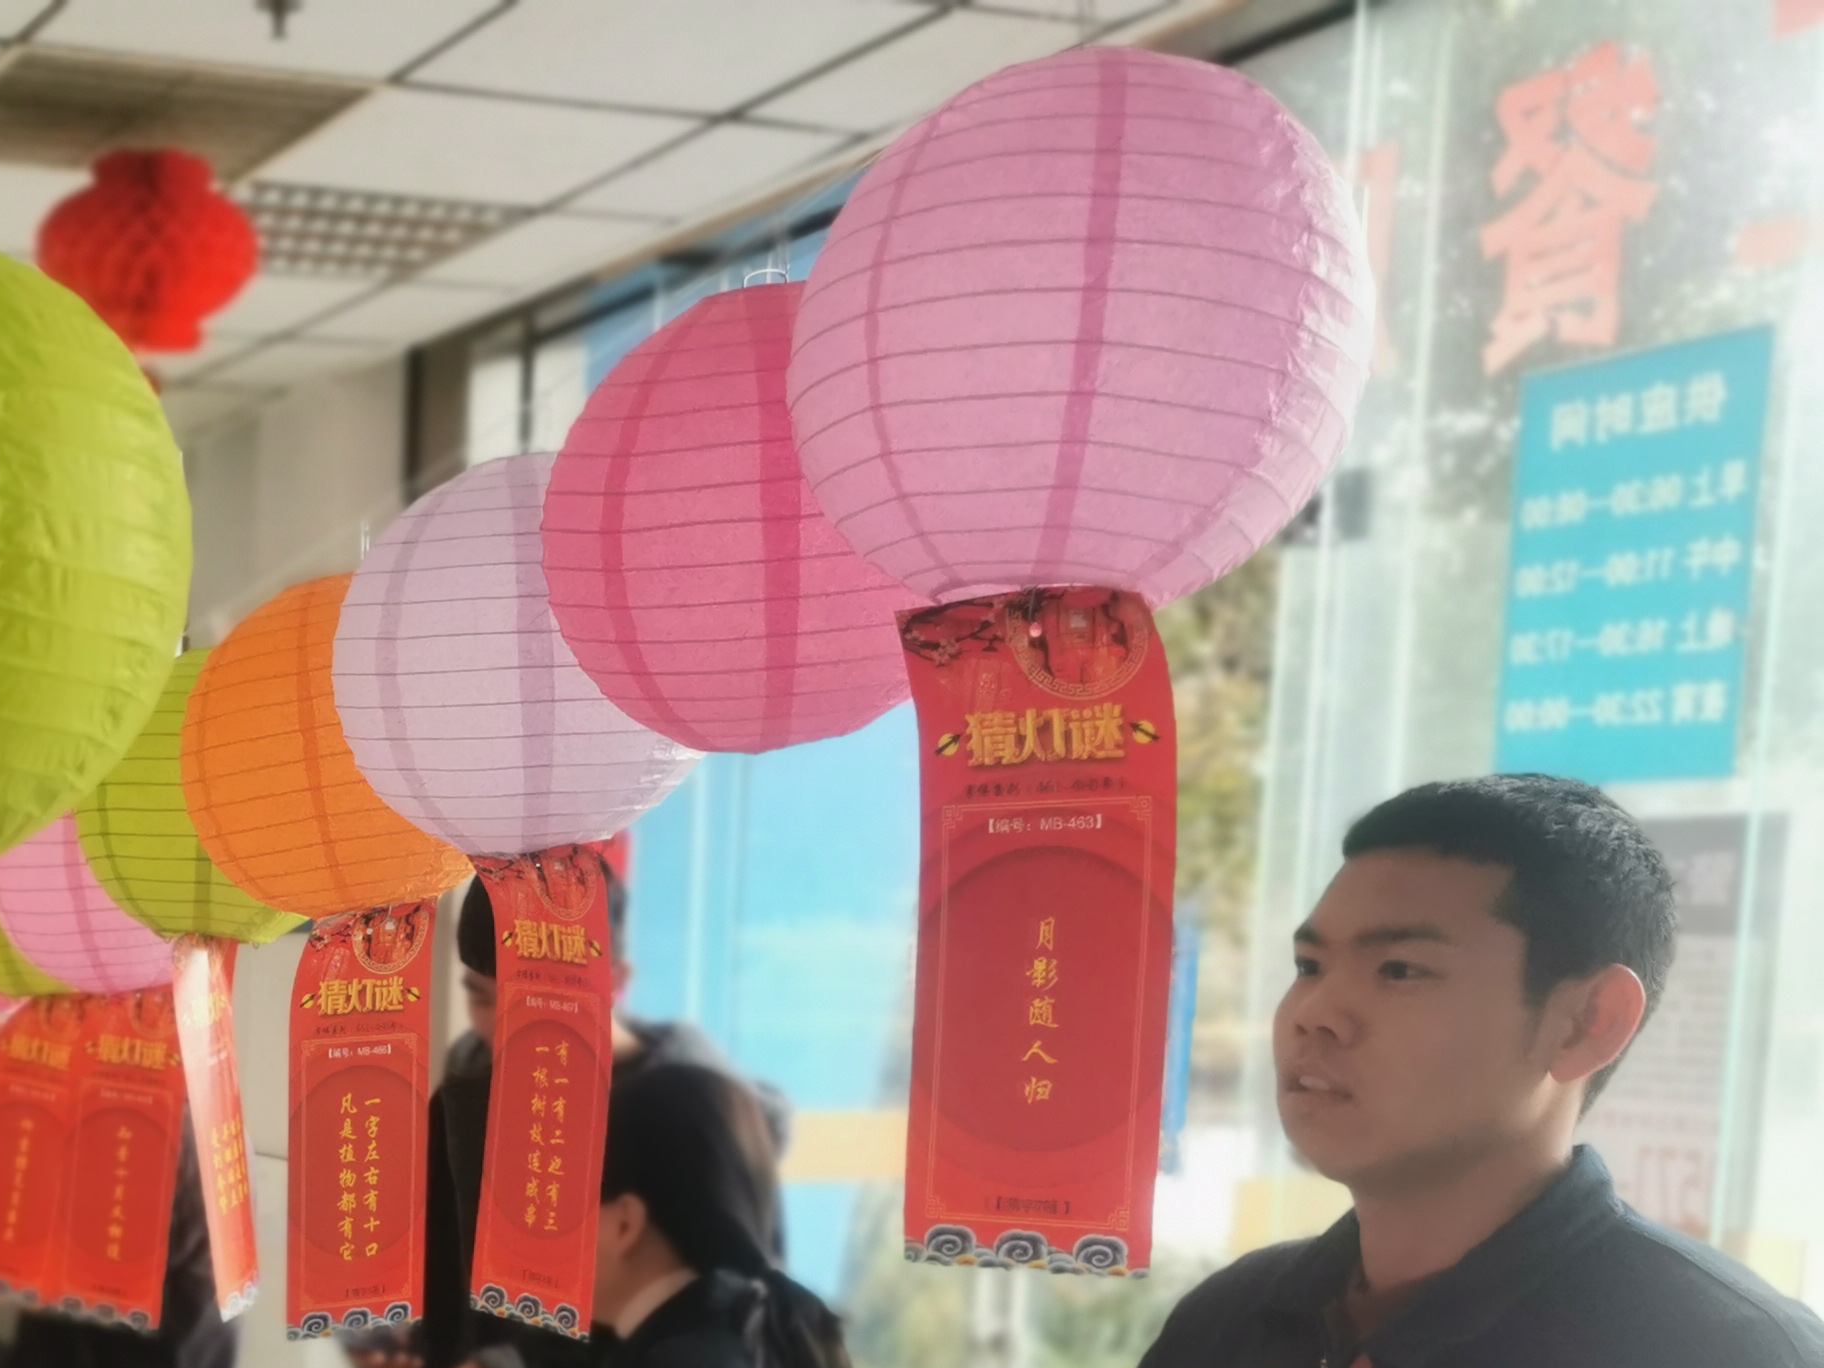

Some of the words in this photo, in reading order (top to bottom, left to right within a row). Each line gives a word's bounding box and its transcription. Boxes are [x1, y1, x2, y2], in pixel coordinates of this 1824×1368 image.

[964, 702, 1126, 768] 猜灯谜
[317, 975, 404, 1016] 猜灯谜
[514, 918, 588, 965] 猜灯谜
[1021, 916, 1059, 1105] 月影随人归
[337, 1093, 358, 1261] 凡是植物都有它
[363, 1097, 382, 1258] 一字左右有十口
